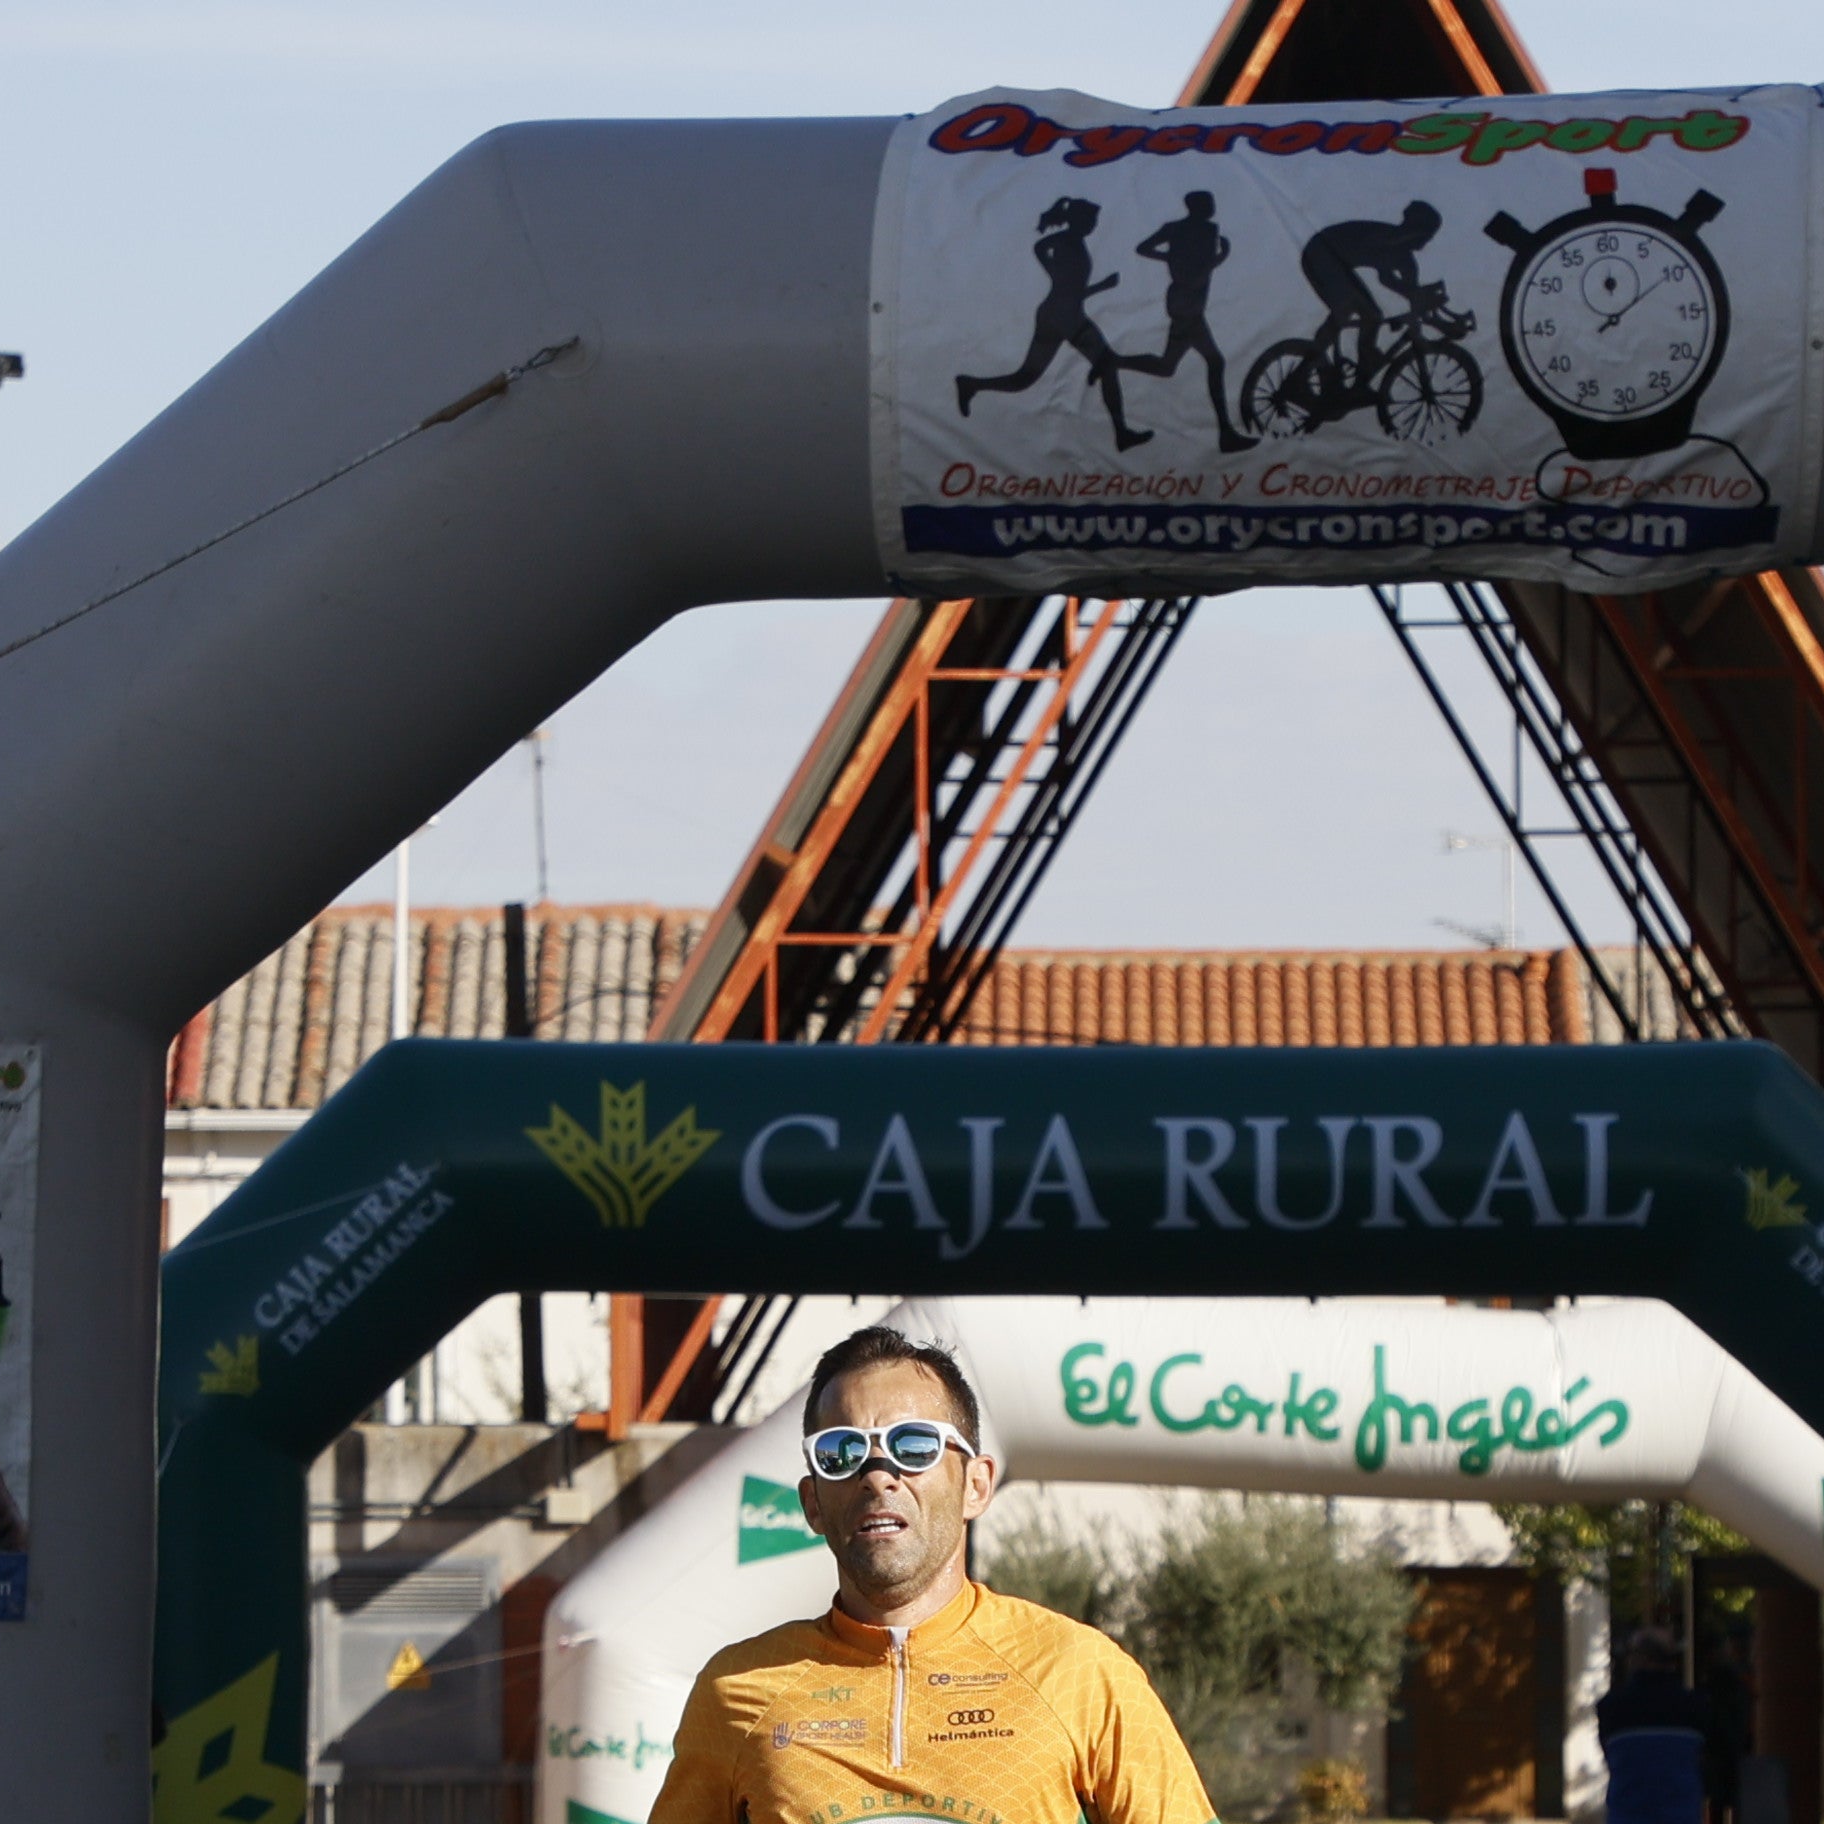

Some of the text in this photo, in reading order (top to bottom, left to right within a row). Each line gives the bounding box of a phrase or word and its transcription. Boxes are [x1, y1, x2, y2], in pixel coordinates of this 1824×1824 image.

[928, 103, 1751, 168] OrycronSport
[1596, 236, 1619, 251] 60
[1637, 242, 1650, 259] 5
[1562, 251, 1584, 268] 55
[1663, 266, 1684, 282] 10
[1540, 278, 1563, 294] 50
[1679, 303, 1700, 320] 15
[1533, 321, 1556, 336] 45
[1669, 342, 1692, 361] 20
[1548, 356, 1571, 373] 40
[1578, 380, 1600, 397] 35
[1648, 371, 1672, 389] 25
[1614, 387, 1636, 405] 30
[939, 462, 1204, 498] ORGANIZACIÓN
[1259, 463, 1538, 501] CRONOMETRAJE
[1561, 466, 1752, 501] DEPORTIVO
[992, 510, 1687, 551] www.orycronsport.com
[740, 1110, 1654, 1260] CAJA RURAL
[254, 1160, 441, 1328] CAJA RURAL
[279, 1191, 454, 1355] DE SALAMANCA
[1060, 1342, 1629, 1476] El Corte Inglés
[797, 1719, 867, 1732] CORPORE
[928, 1728, 1014, 1743] Helmántica
